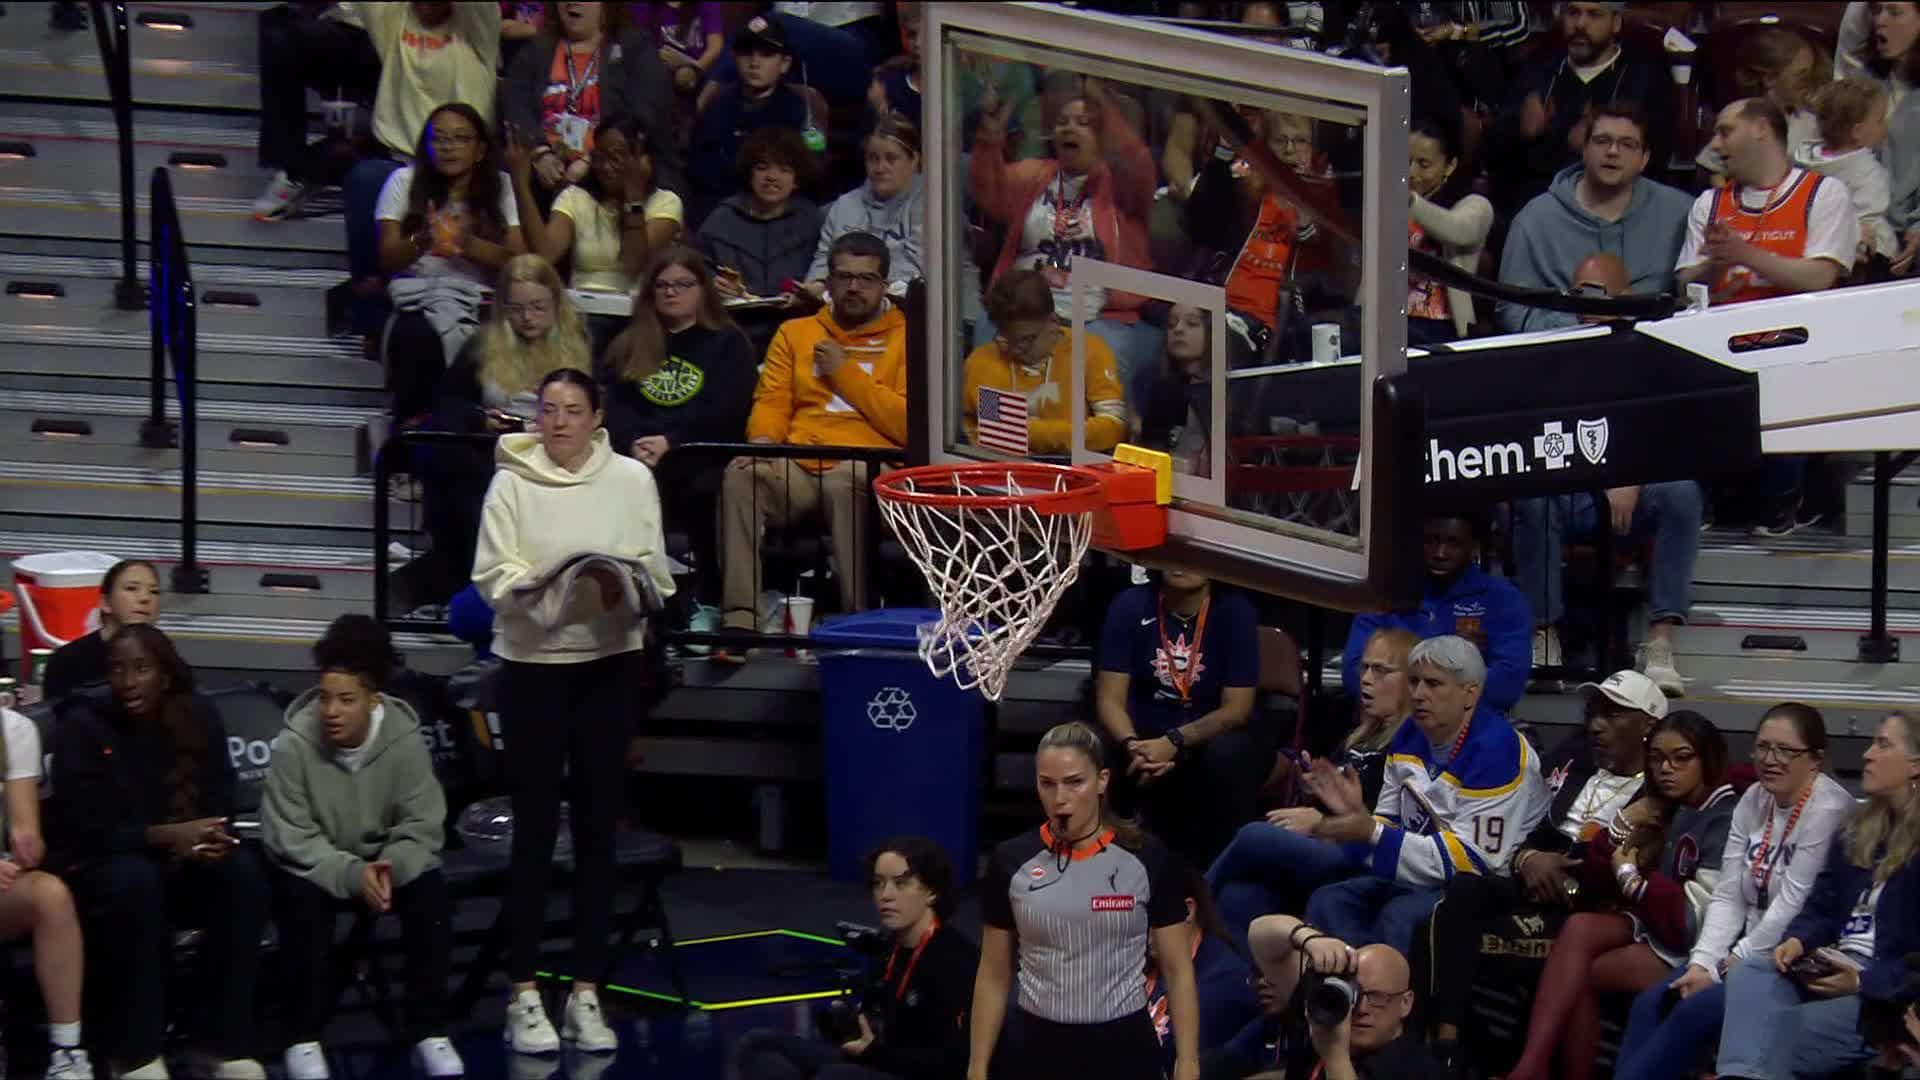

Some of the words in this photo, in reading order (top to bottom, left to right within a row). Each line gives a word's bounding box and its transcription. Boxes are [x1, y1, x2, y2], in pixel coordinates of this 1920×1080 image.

[228, 736, 278, 768] Po
[1472, 815, 1504, 854] 19
[1092, 898, 1133, 910] Emirates
